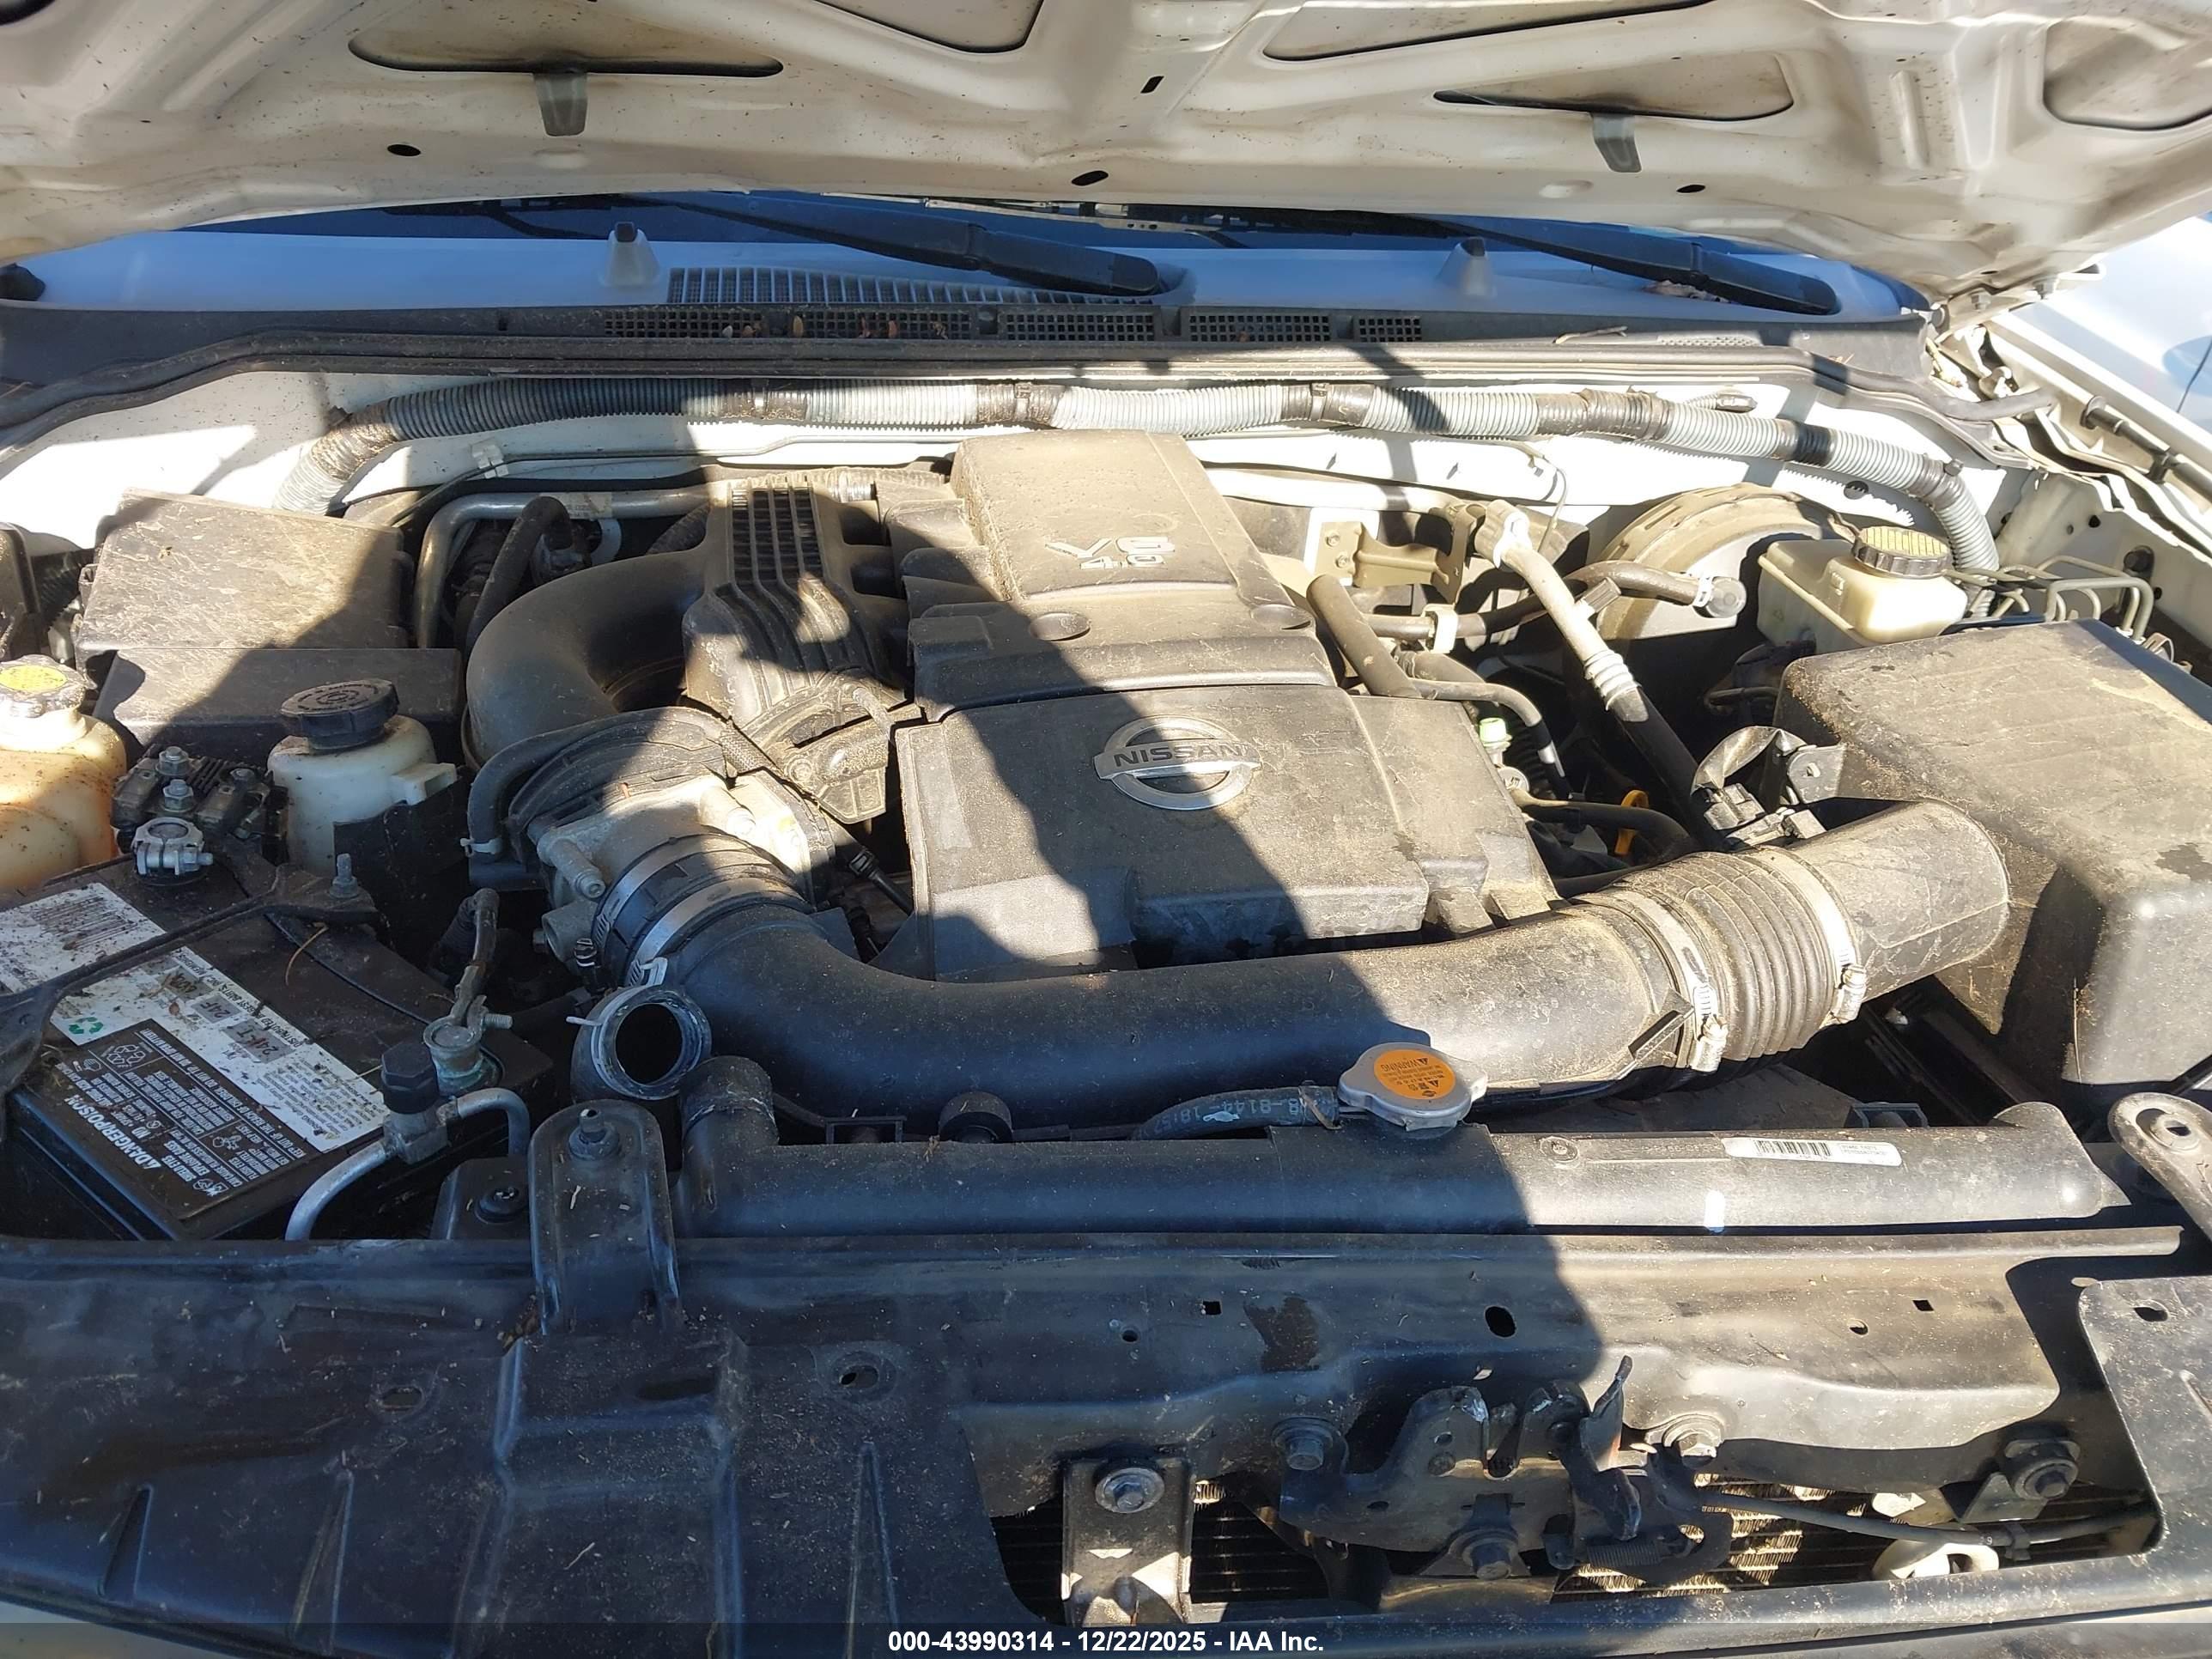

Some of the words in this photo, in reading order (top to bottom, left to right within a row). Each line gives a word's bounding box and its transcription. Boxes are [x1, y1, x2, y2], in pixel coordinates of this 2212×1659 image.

[1113, 742, 1244, 767] NISSAN
[199, 998, 230, 1019] 24F
[259, 1017, 303, 1048] DISTRIBUTED
[63, 1093, 153, 1164] DANGER/POISON
[130, 1125, 152, 1139] NO
